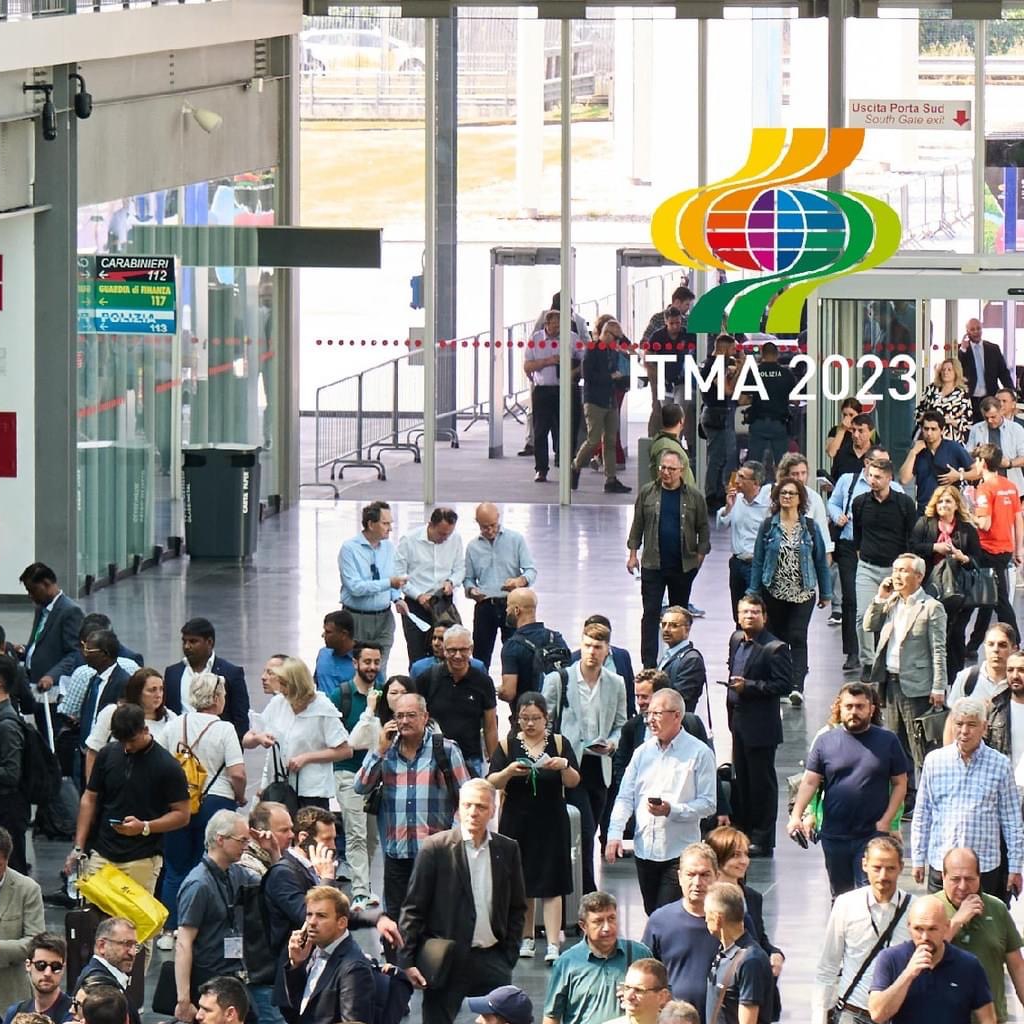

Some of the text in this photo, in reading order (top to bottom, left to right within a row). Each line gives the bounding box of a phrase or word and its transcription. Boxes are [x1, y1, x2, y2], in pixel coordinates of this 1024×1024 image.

[852, 103, 944, 114] Uscita Porta Sud
[865, 114, 895, 124] South
[101, 258, 168, 269] CARABINIERI
[148, 270, 167, 281] 112
[132, 285, 139, 294] di
[151, 295, 166, 306] 117
[101, 312, 156, 323] POLIZIA
[150, 323, 167, 332] 113
